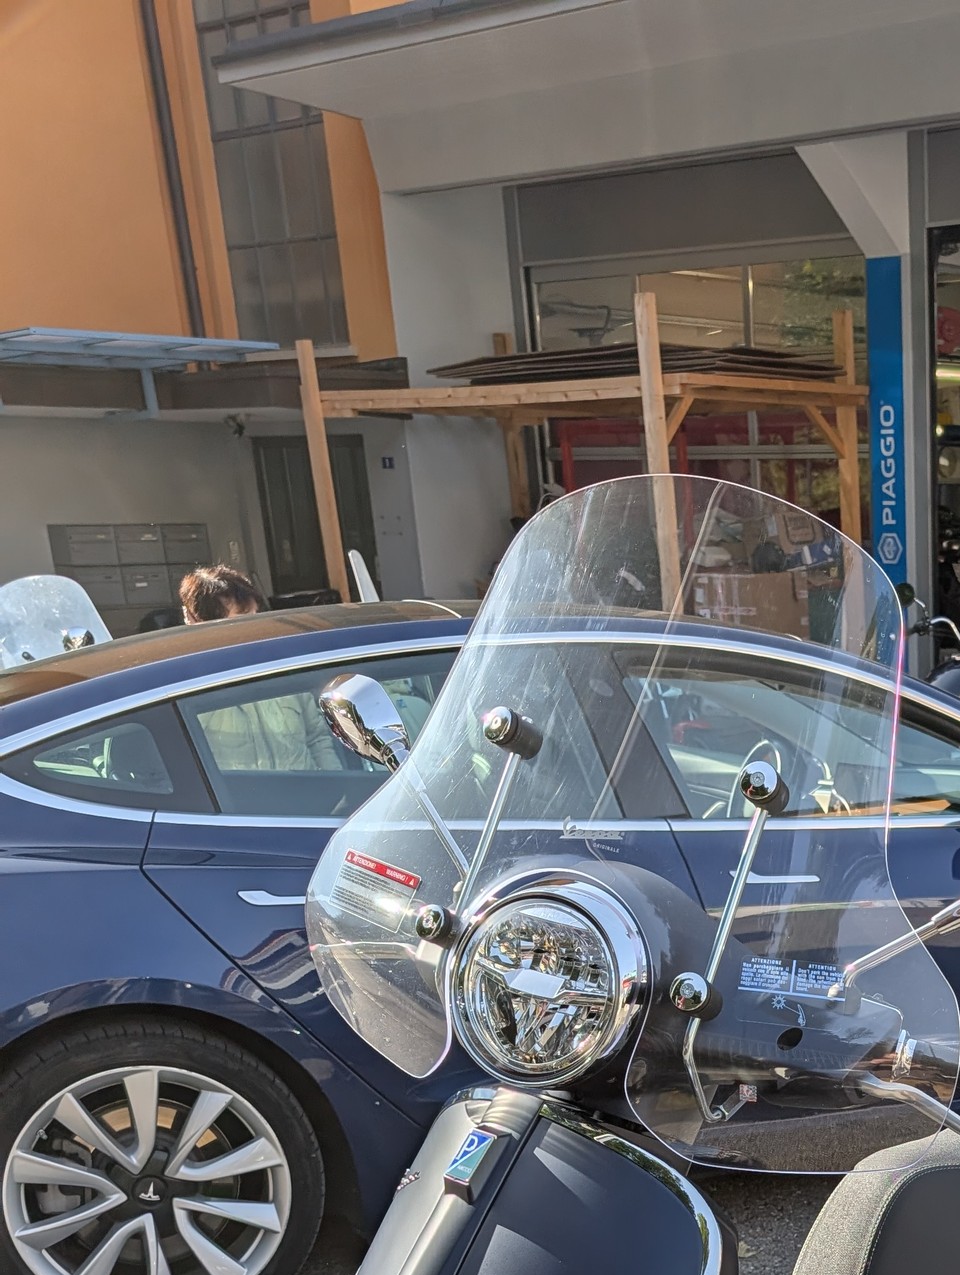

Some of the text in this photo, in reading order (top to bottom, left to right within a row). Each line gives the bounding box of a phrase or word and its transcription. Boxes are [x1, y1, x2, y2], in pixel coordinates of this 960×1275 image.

[879, 404, 898, 526] PIAGGIO
[559, 815, 626, 842] Vespa
[593, 842, 621, 854] ORIGINALE
[751, 957, 783, 966] ATTENZIONE
[808, 963, 838, 972] ATTENTION
